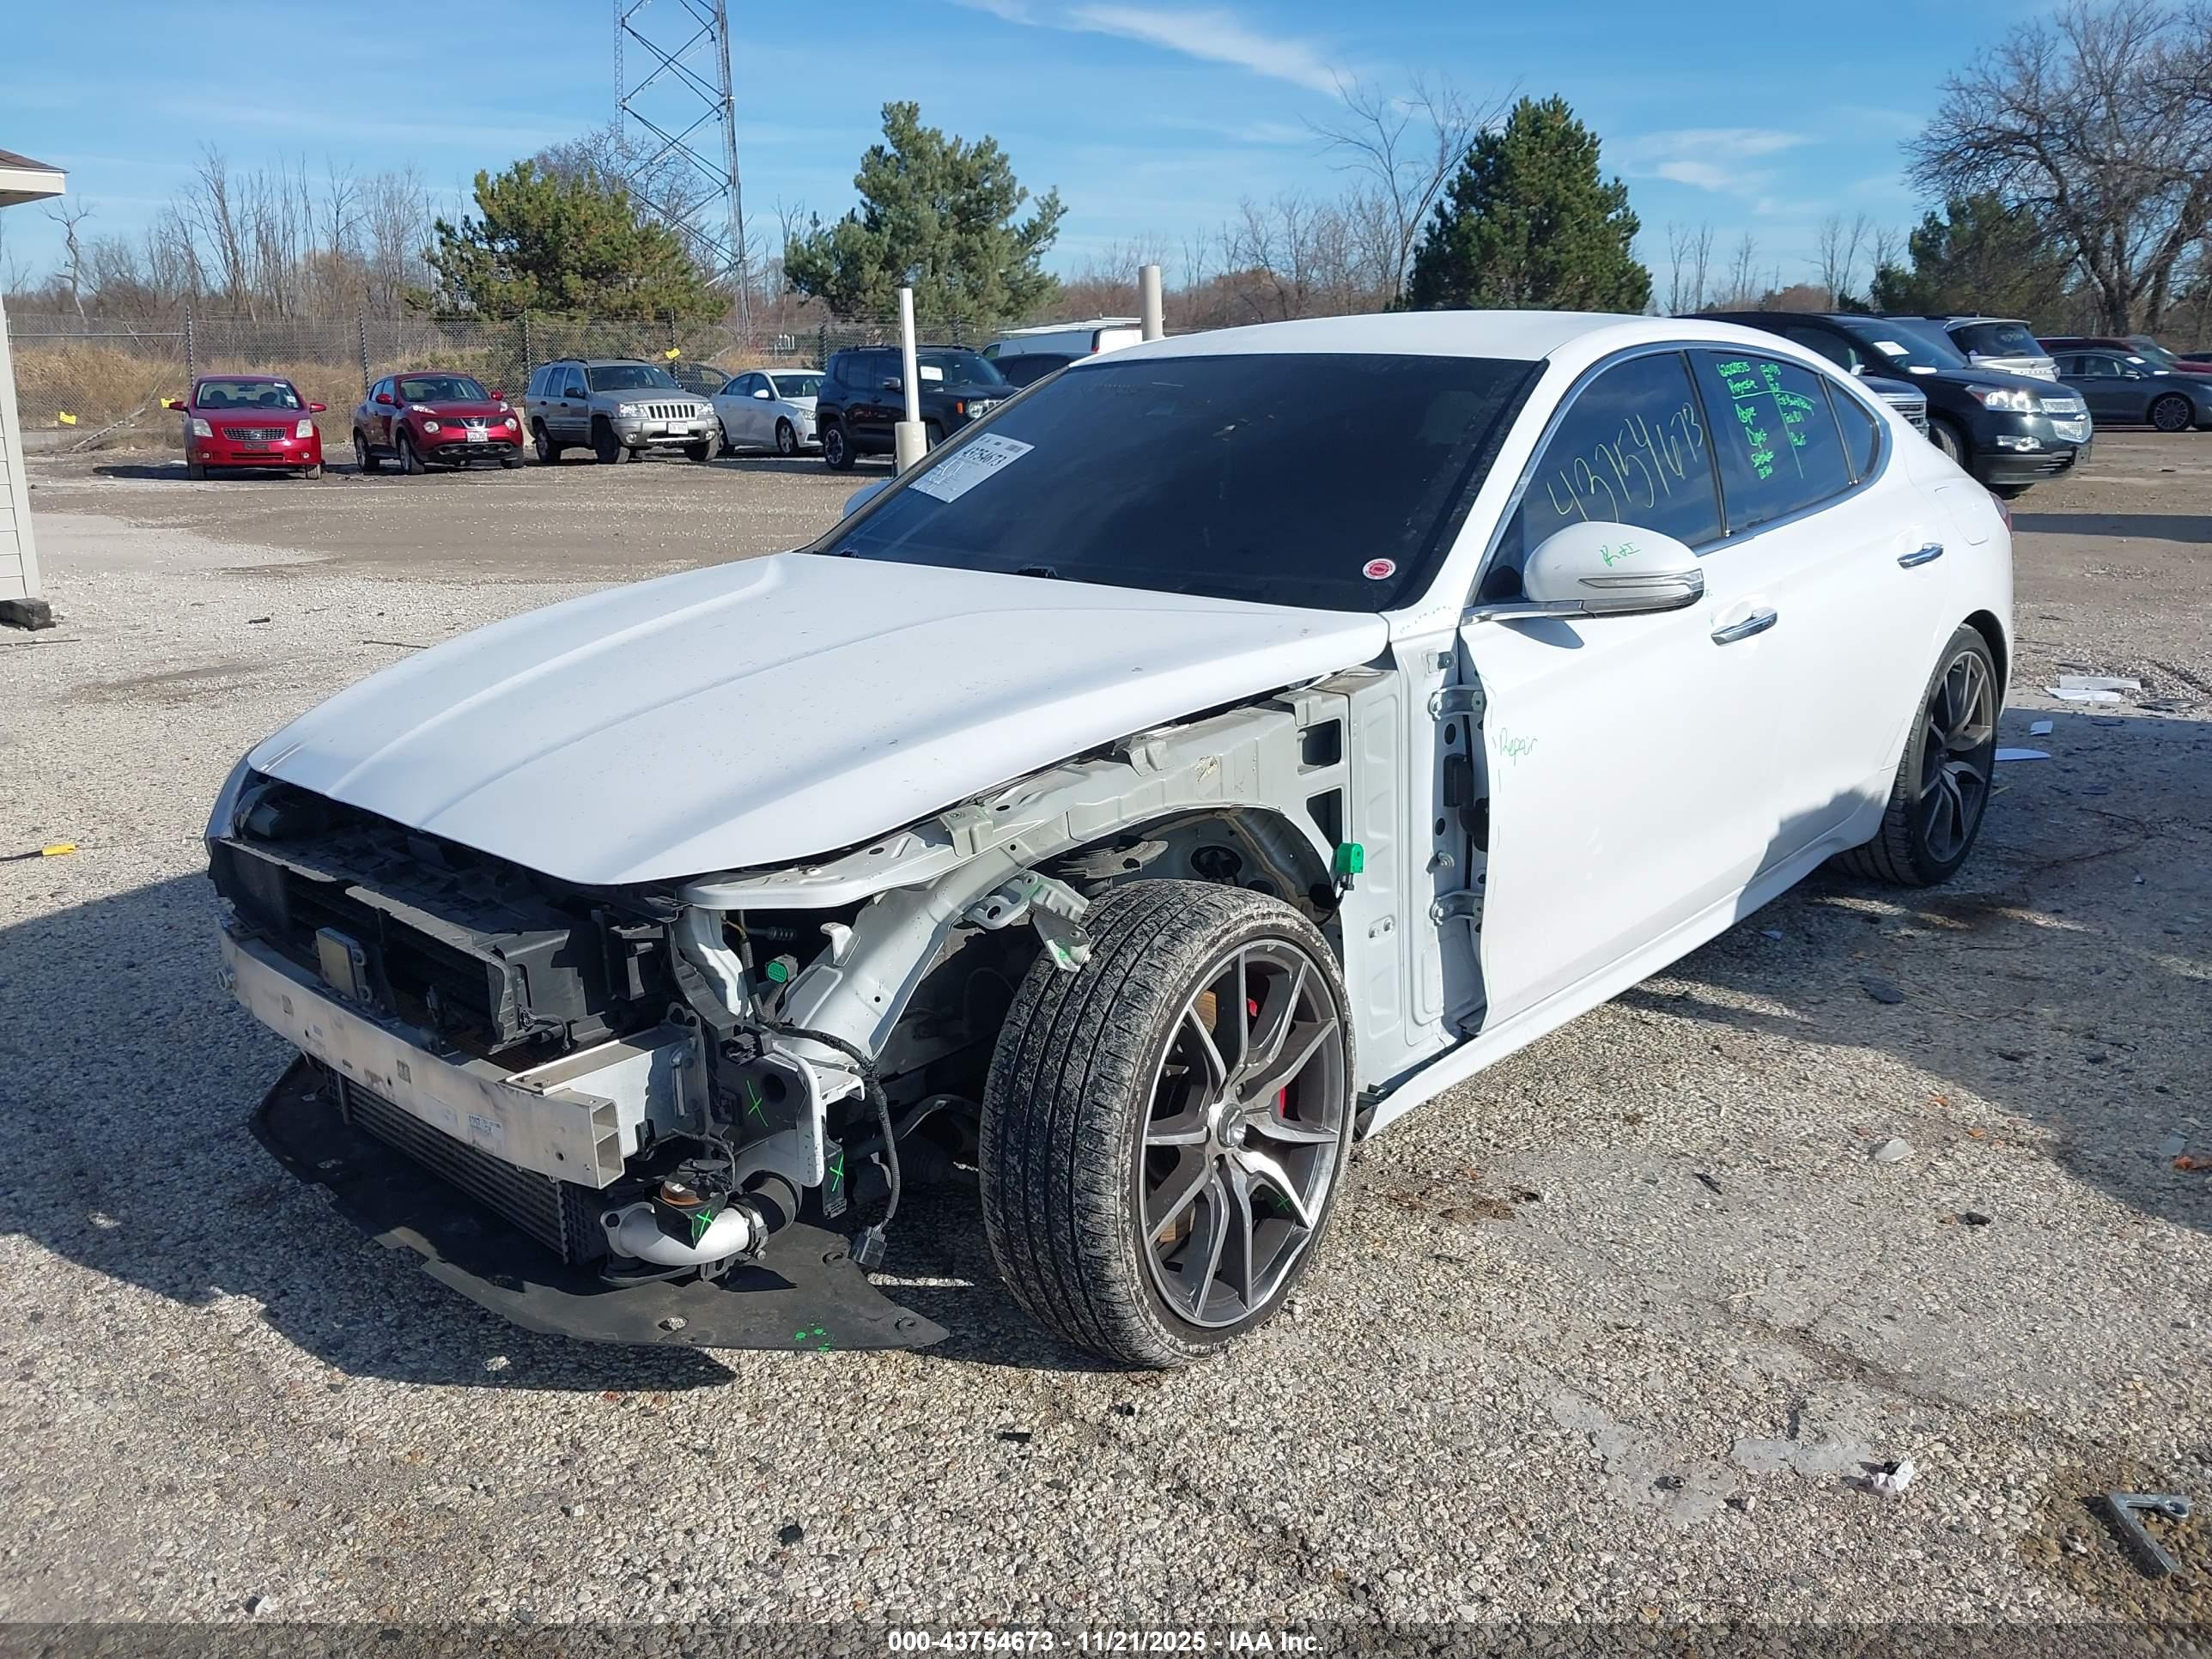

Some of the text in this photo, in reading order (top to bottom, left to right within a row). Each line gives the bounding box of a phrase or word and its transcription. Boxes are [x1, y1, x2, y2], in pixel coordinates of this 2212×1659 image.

[962, 447, 1007, 466] 43754673
[1546, 402, 1705, 523] 43754673
[1498, 727, 1539, 767] Repair
